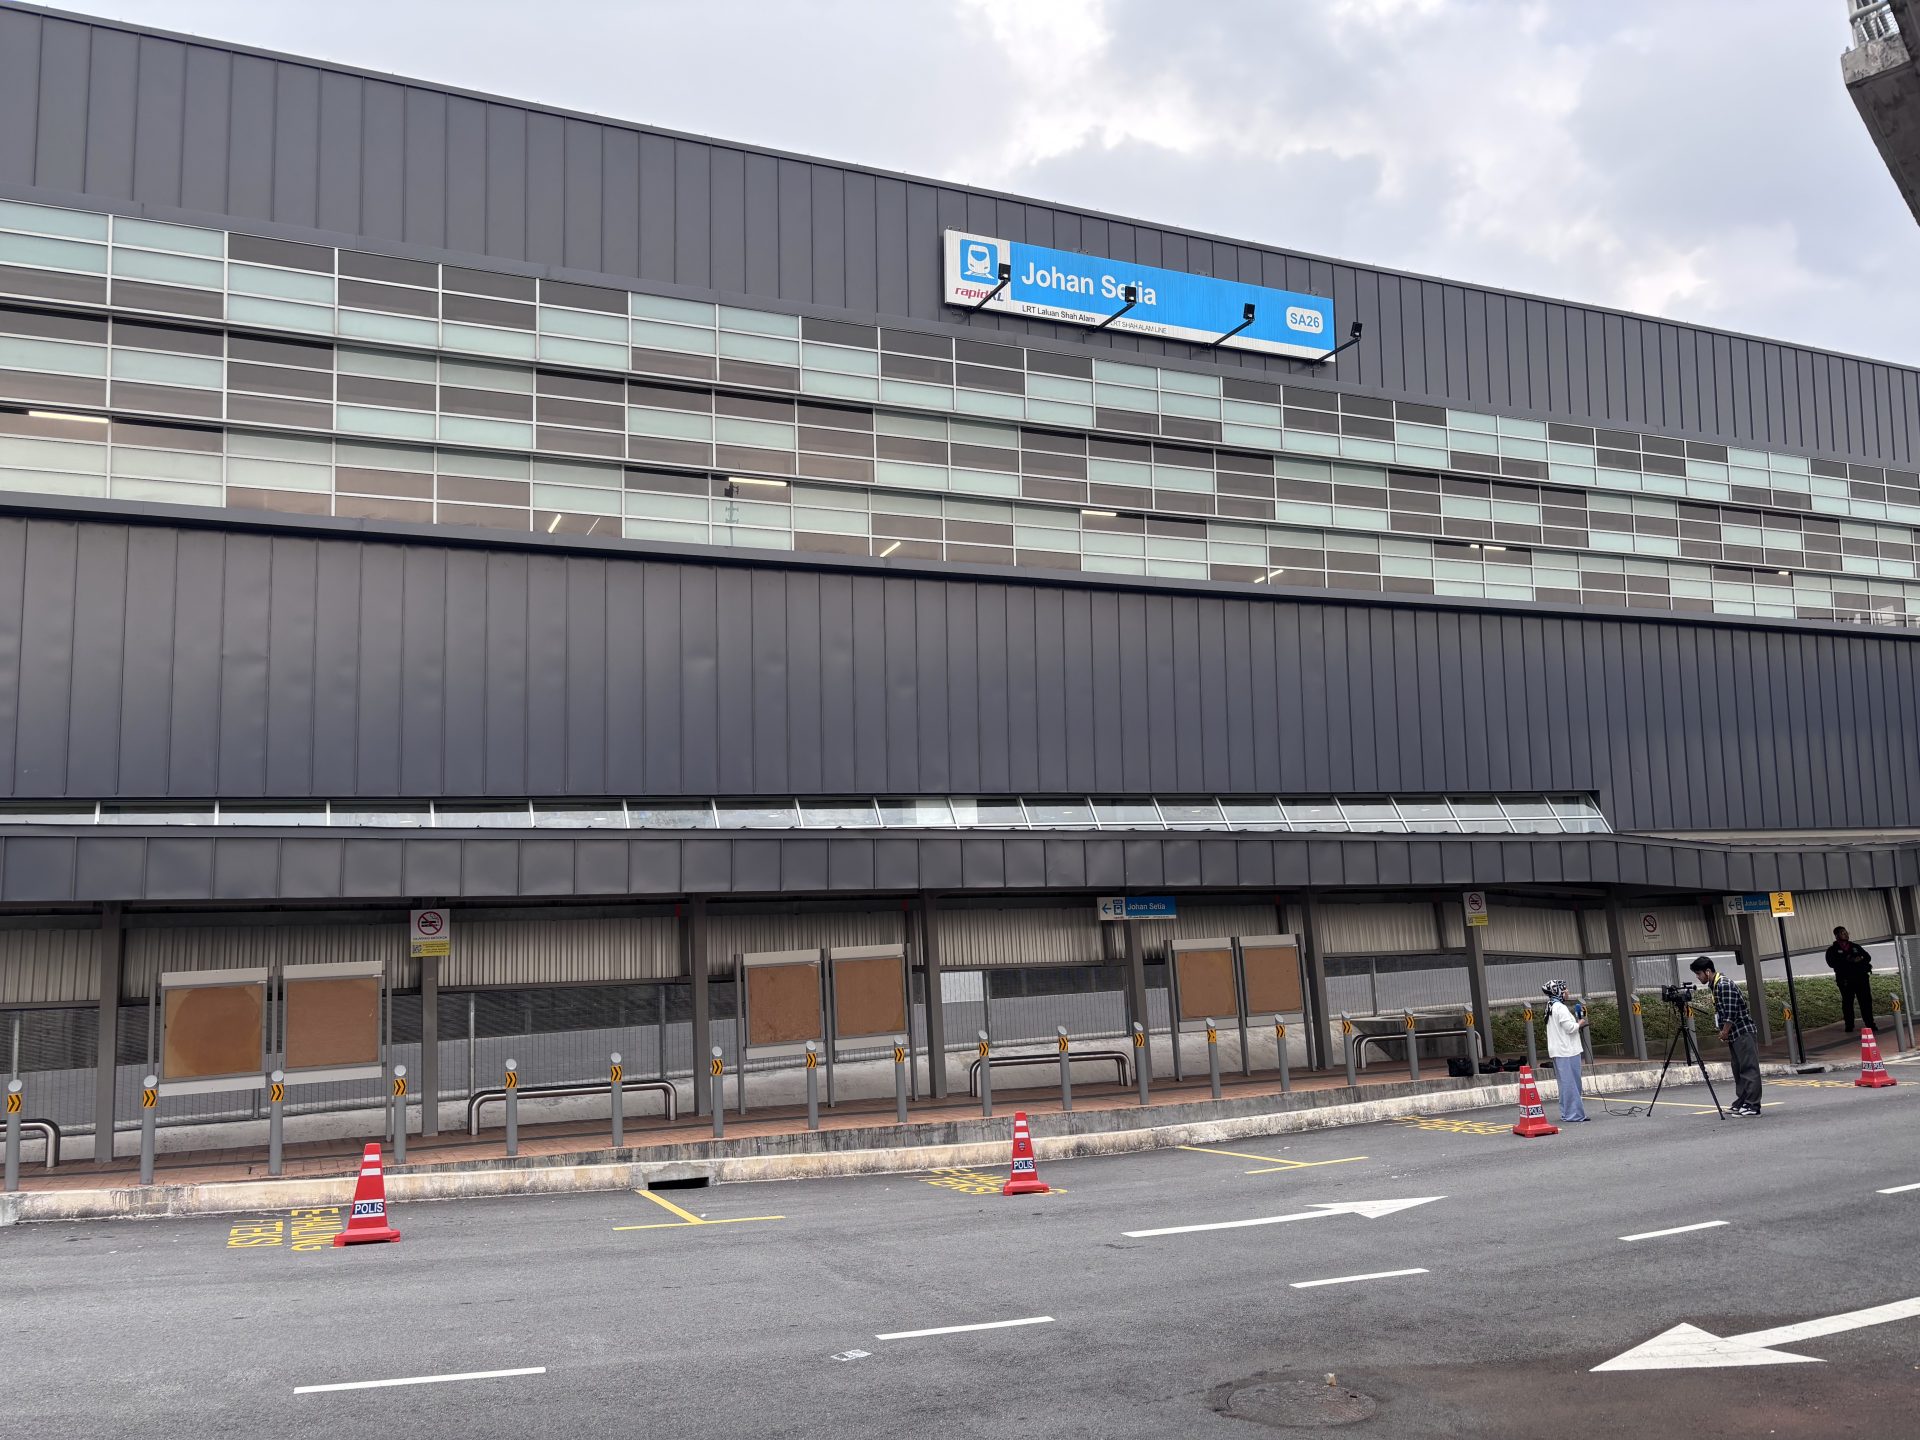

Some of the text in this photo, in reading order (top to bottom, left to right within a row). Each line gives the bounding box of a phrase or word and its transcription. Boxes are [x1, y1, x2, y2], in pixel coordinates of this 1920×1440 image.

[1021, 262, 1094, 295] Johan
[1021, 304, 1096, 323] LRT Laluan Shah Alam
[1290, 312, 1320, 328] SA26
[1121, 320, 1138, 329] SHAH
[1138, 323, 1154, 332] ALAM
[1154, 325, 1168, 333] LINE
[1127, 902, 1148, 911] Johan
[1149, 902, 1166, 910] Setia
[1013, 1160, 1034, 1169] POLIS
[354, 1201, 384, 1214] POLIS
